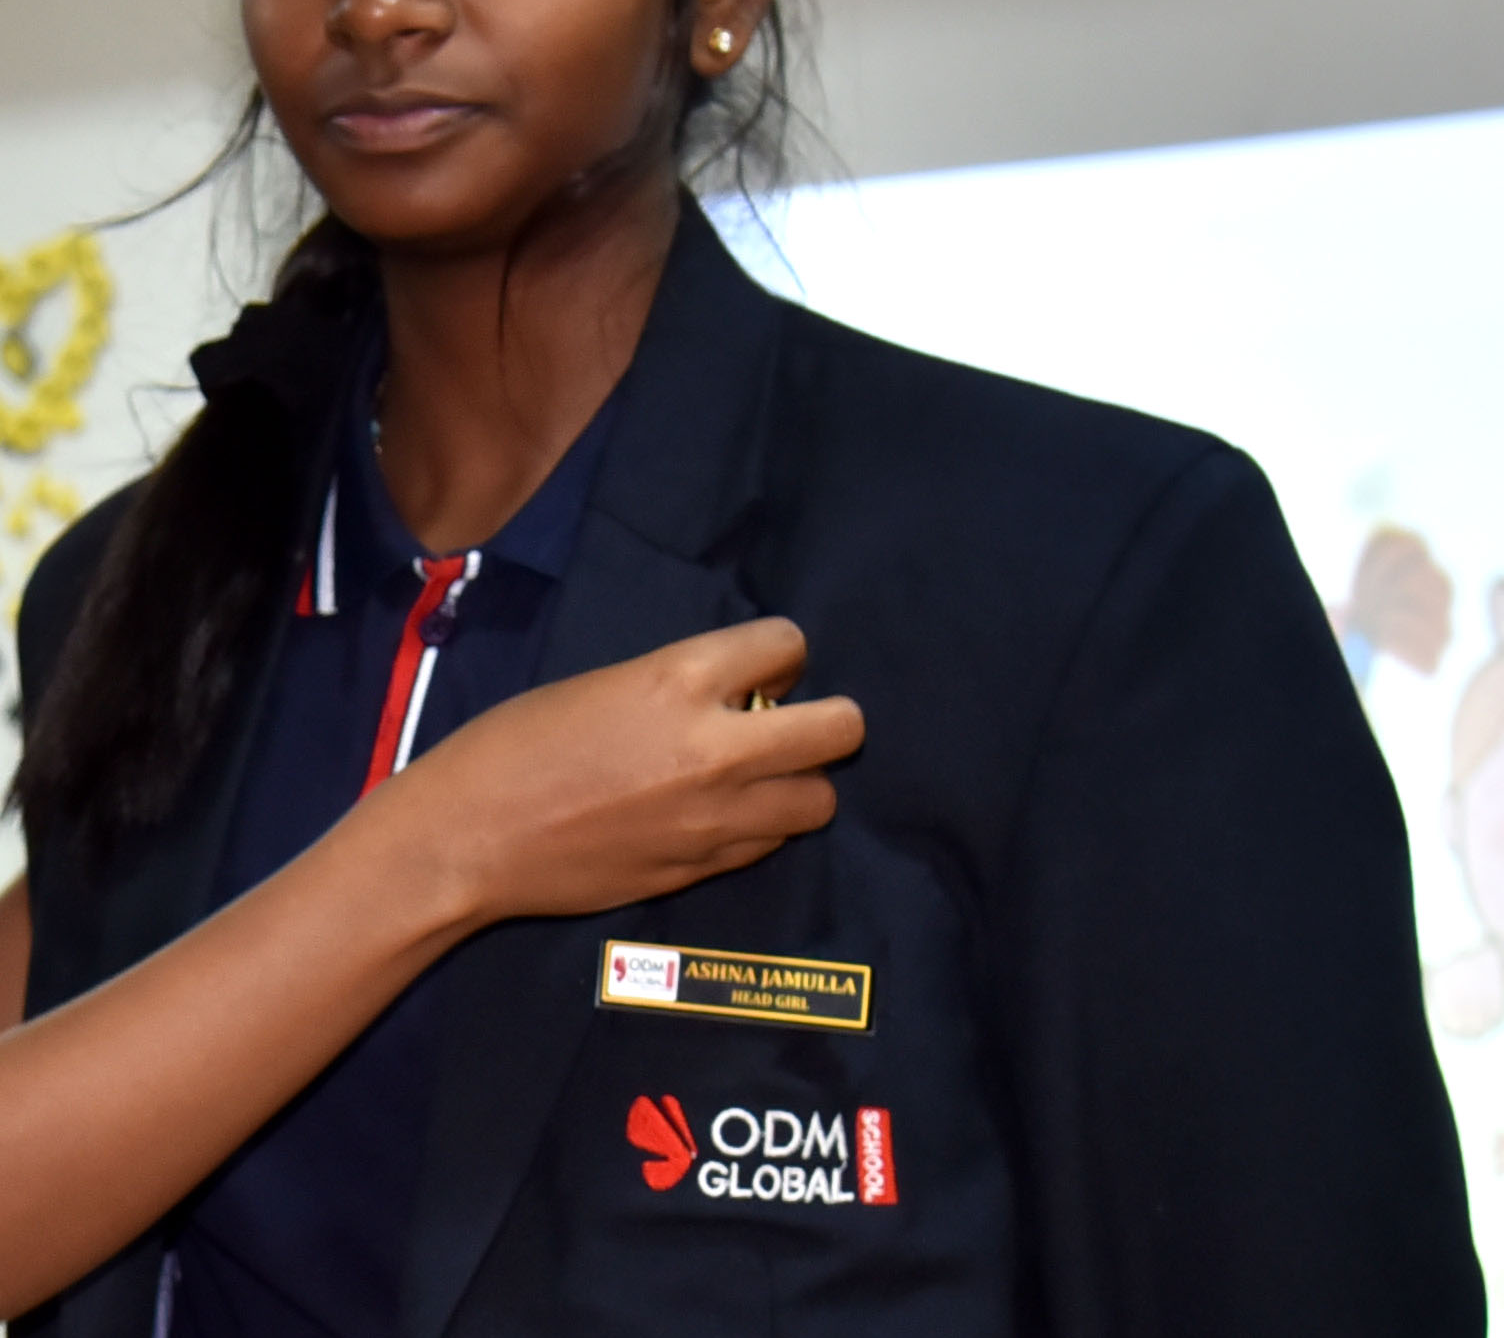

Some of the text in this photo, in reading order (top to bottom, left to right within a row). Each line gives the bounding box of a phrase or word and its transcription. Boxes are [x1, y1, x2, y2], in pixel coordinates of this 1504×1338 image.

[684, 960, 757, 986] ASHNA
[760, 967, 857, 996] JAMULLA
[731, 988, 811, 1012] HEAD GIRL
[711, 1107, 849, 1160] ODM
[861, 1108, 886, 1204] SCHOOL
[697, 1160, 856, 1206] GLOBAL
